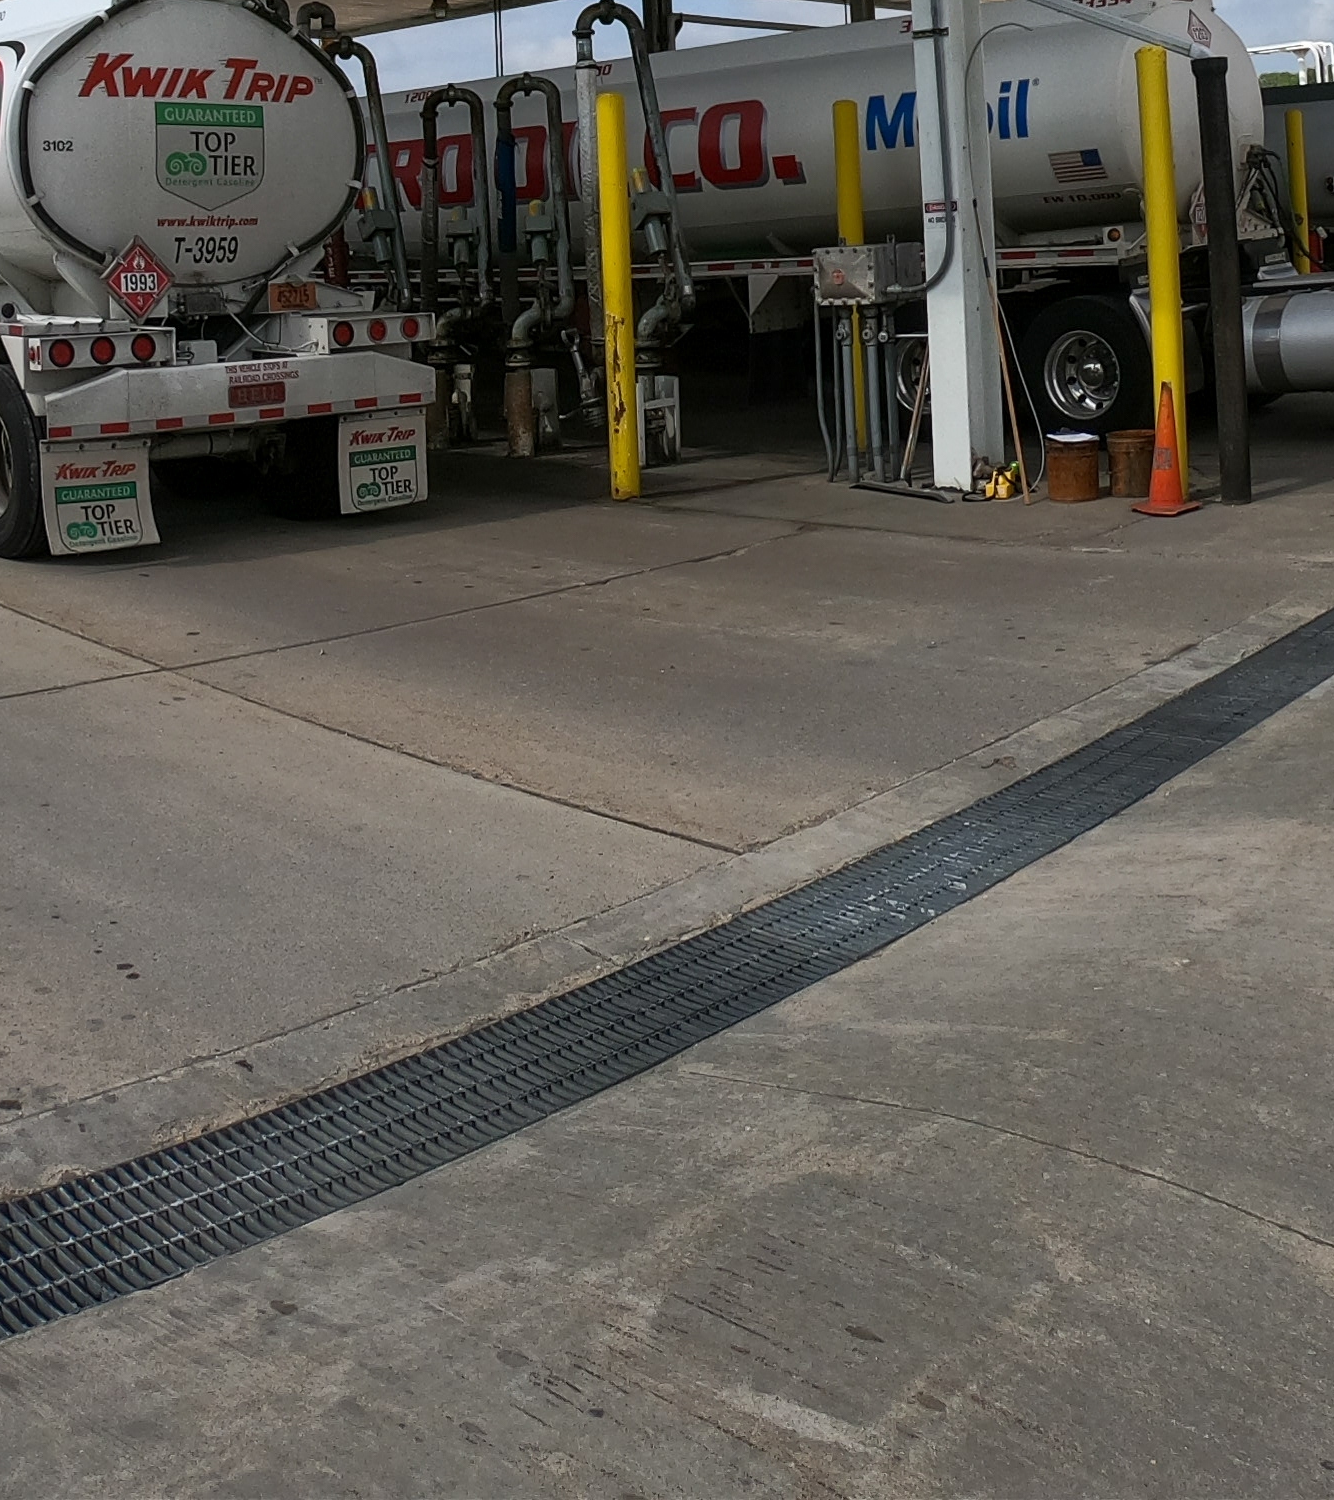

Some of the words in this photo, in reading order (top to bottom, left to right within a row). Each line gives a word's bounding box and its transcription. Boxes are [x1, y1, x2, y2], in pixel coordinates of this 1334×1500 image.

[78, 53, 215, 98] KWIK
[223, 58, 314, 103] TRIP
[165, 108, 256, 124] GUARANTEED
[866, 78, 1030, 150] Mil
[43, 141, 73, 152] 3102
[190, 132, 236, 152] TOP
[209, 155, 257, 176] TIER
[157, 215, 258, 228] www.kwiktrip.com
[175, 236, 238, 263] T-3959
[123, 273, 157, 291] 1993
[354, 449, 410, 464] GUARANTEED
[369, 466, 398, 481] TOP
[62, 486, 130, 501] GUARANTEED
[382, 479, 411, 495] TIER
[80, 504, 115, 521] TOP
[96, 519, 136, 536] TIER
